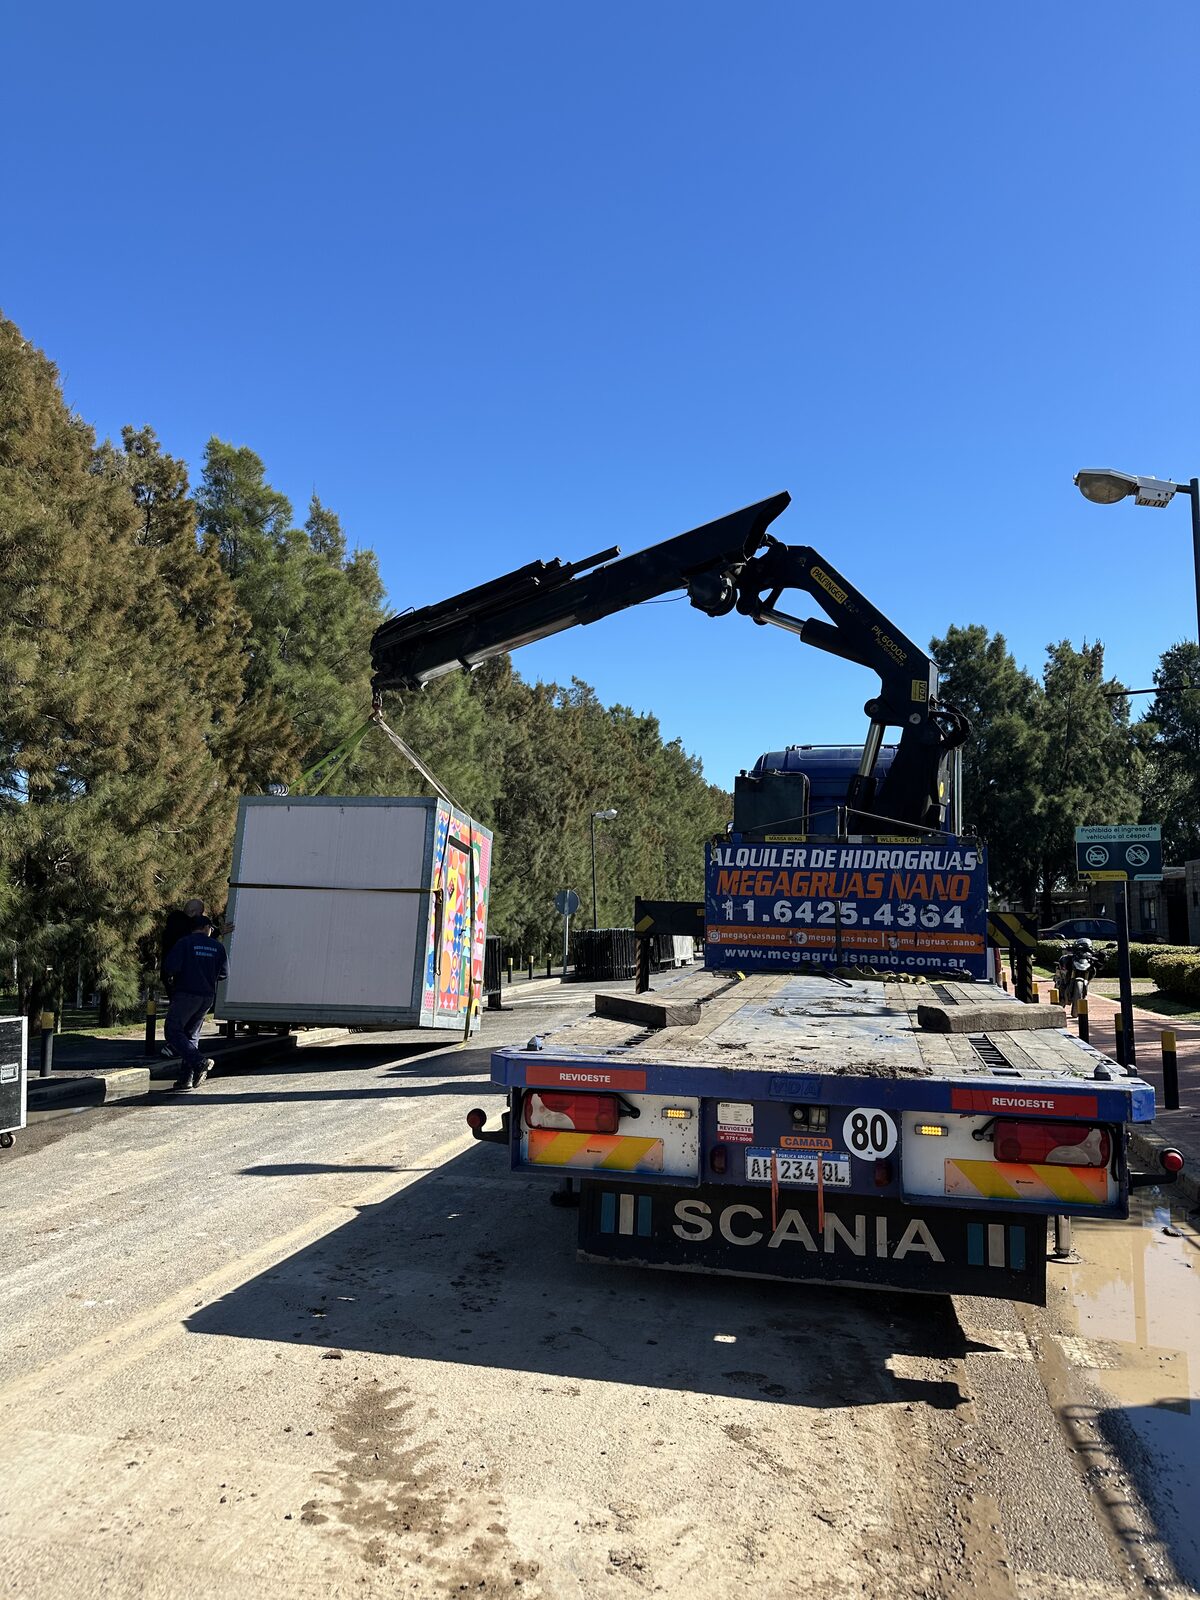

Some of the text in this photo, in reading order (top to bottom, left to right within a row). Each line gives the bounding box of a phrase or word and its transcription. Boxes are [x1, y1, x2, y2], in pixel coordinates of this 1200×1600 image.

[812, 568, 846, 602] PALFINGER
[871, 625, 908, 661] PK 60002
[1121, 826, 1147, 834] ingreso
[710, 848, 978, 871] ALQUILER DE HIDROGRUAS
[716, 870, 971, 902] MEGAGRUAS NANO
[722, 899, 965, 929] 11.6425.4364
[721, 932, 786, 941] megagruasnano
[808, 933, 855, 943] megaguas
[559, 1072, 611, 1083] REVIOESTE
[992, 1096, 1055, 1109] REVIOESTE
[785, 1137, 831, 1147] CAMARA
[851, 1113, 889, 1152] 80
[751, 1158, 773, 1178] AH
[780, 1160, 815, 1181] 234
[672, 1199, 946, 1263] SCANIA
